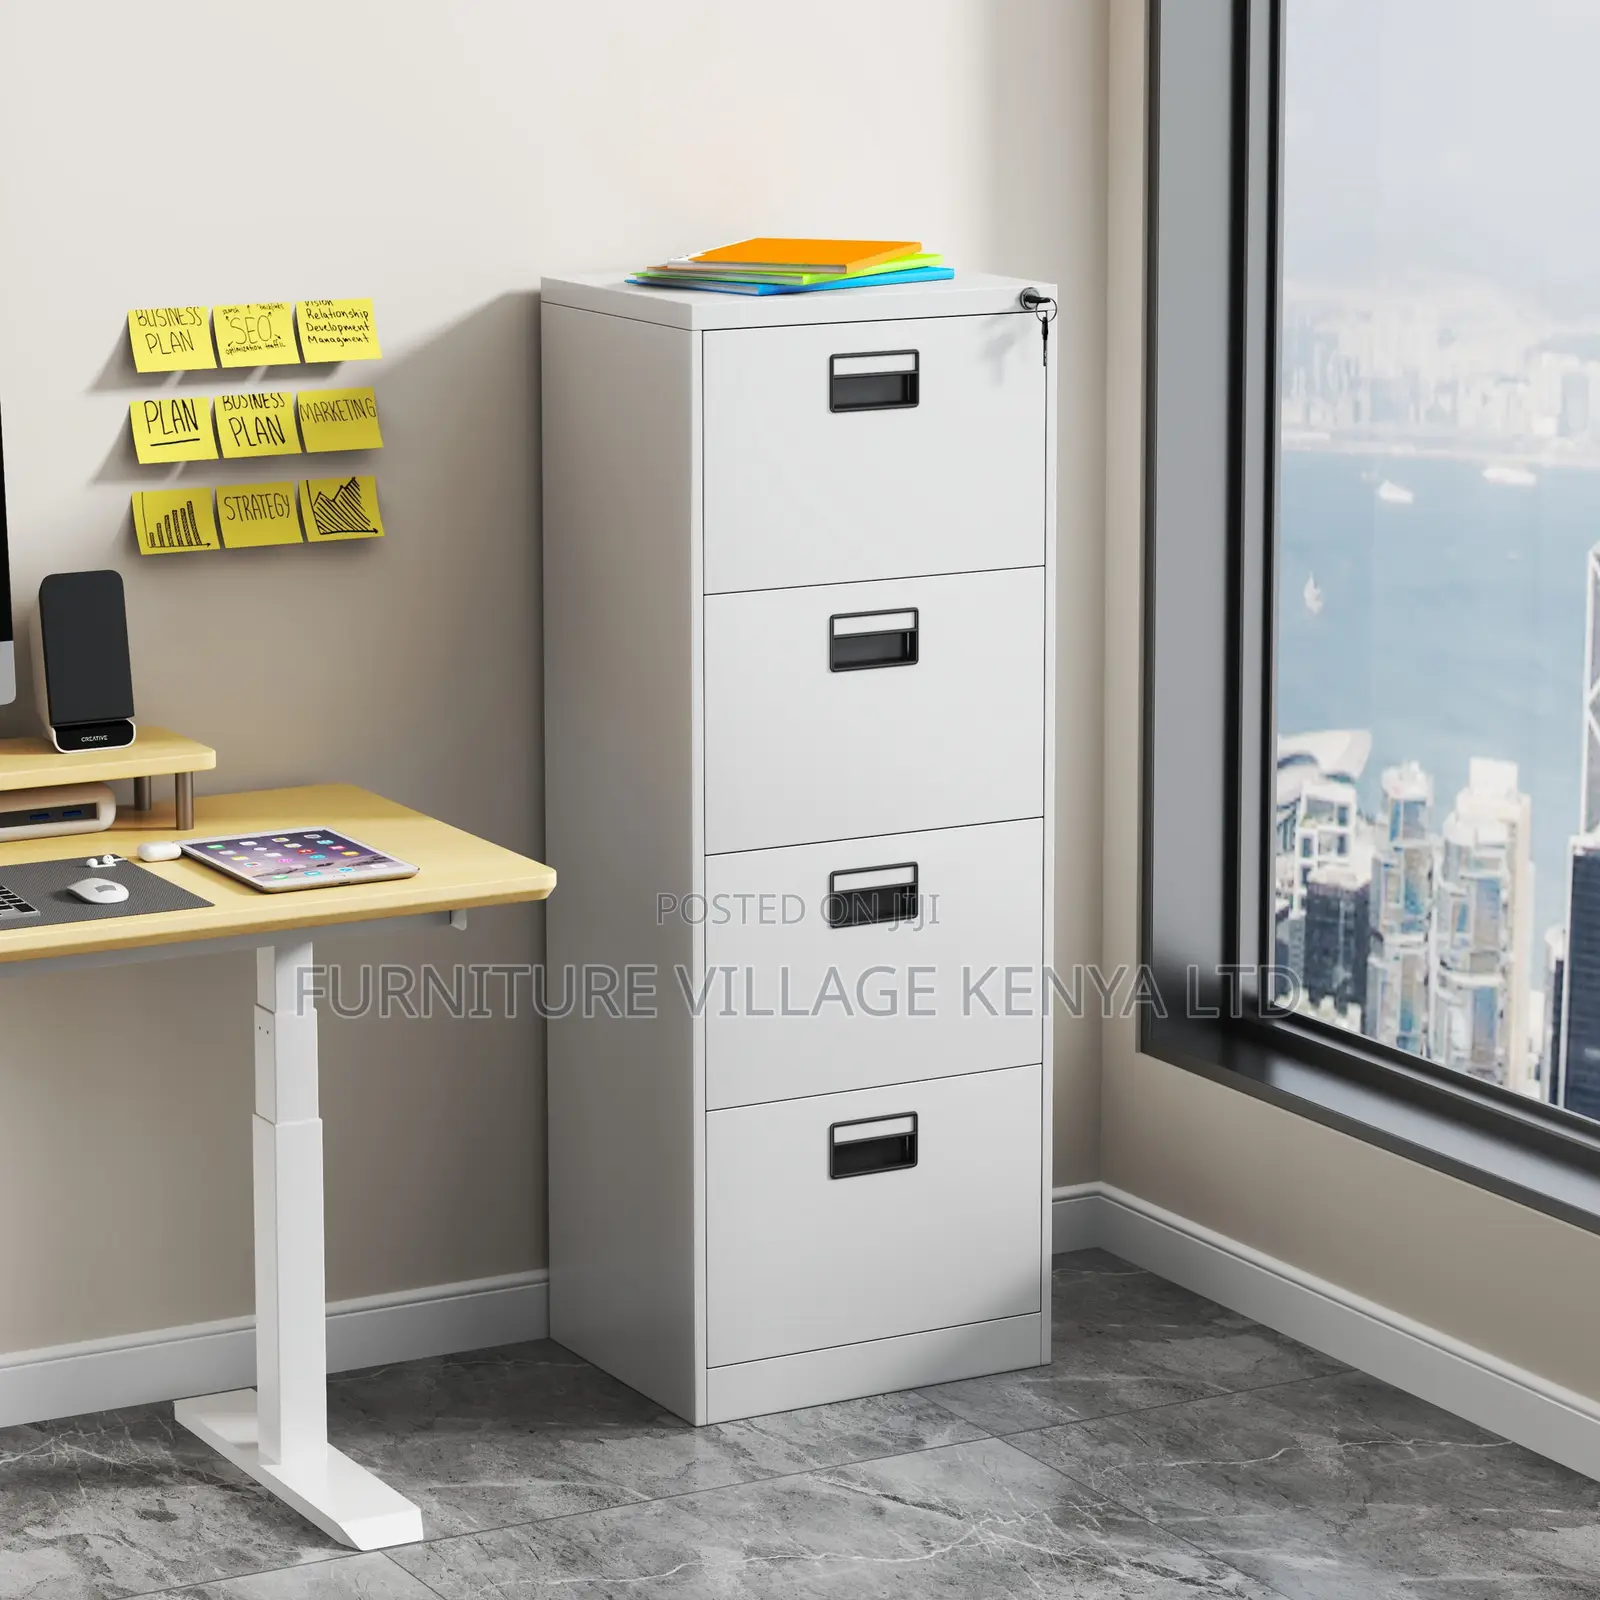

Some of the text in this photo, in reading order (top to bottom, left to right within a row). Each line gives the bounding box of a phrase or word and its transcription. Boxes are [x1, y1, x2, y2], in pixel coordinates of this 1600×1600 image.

[135, 306, 203, 327] BUSINESS
[305, 307, 369, 321] Relationship
[305, 320, 370, 335] Development
[144, 328, 195, 355] PLAN
[229, 314, 273, 344] SEO
[307, 332, 370, 347] Managment
[222, 392, 286, 411] BUSINESS
[300, 397, 377, 424] MARKETING
[143, 398, 199, 435] PLAN
[228, 414, 287, 447] PLAN
[223, 493, 291, 522] STRATEGY
